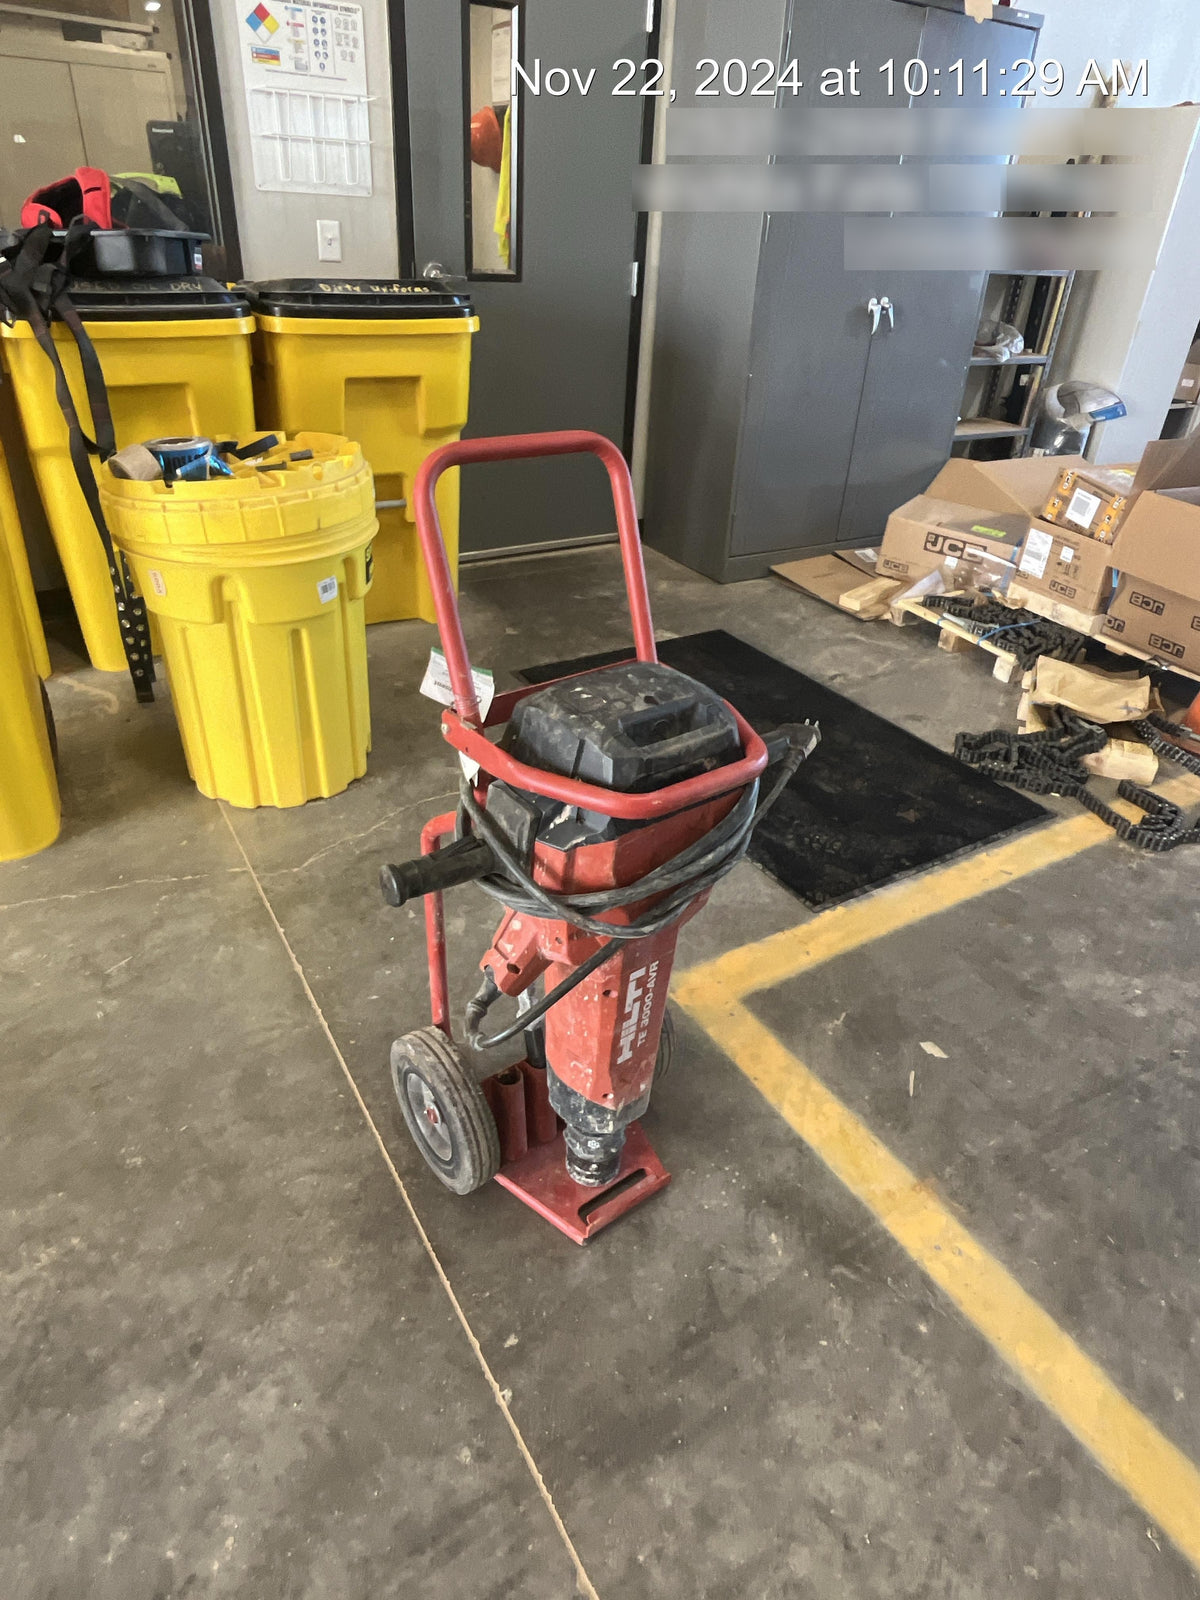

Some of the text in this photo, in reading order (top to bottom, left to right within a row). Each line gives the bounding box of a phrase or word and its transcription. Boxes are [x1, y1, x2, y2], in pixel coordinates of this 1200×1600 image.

[924, 532, 985, 563] JCB
[883, 559, 909, 573] JCB
[1049, 580, 1076, 599] JCB
[1130, 592, 1165, 616] JCB
[1104, 616, 1125, 633] JC
[1148, 634, 1185, 658] JCB
[617, 967, 646, 1065] HILTI
[637, 960, 659, 1048] TE 3000-AVR
